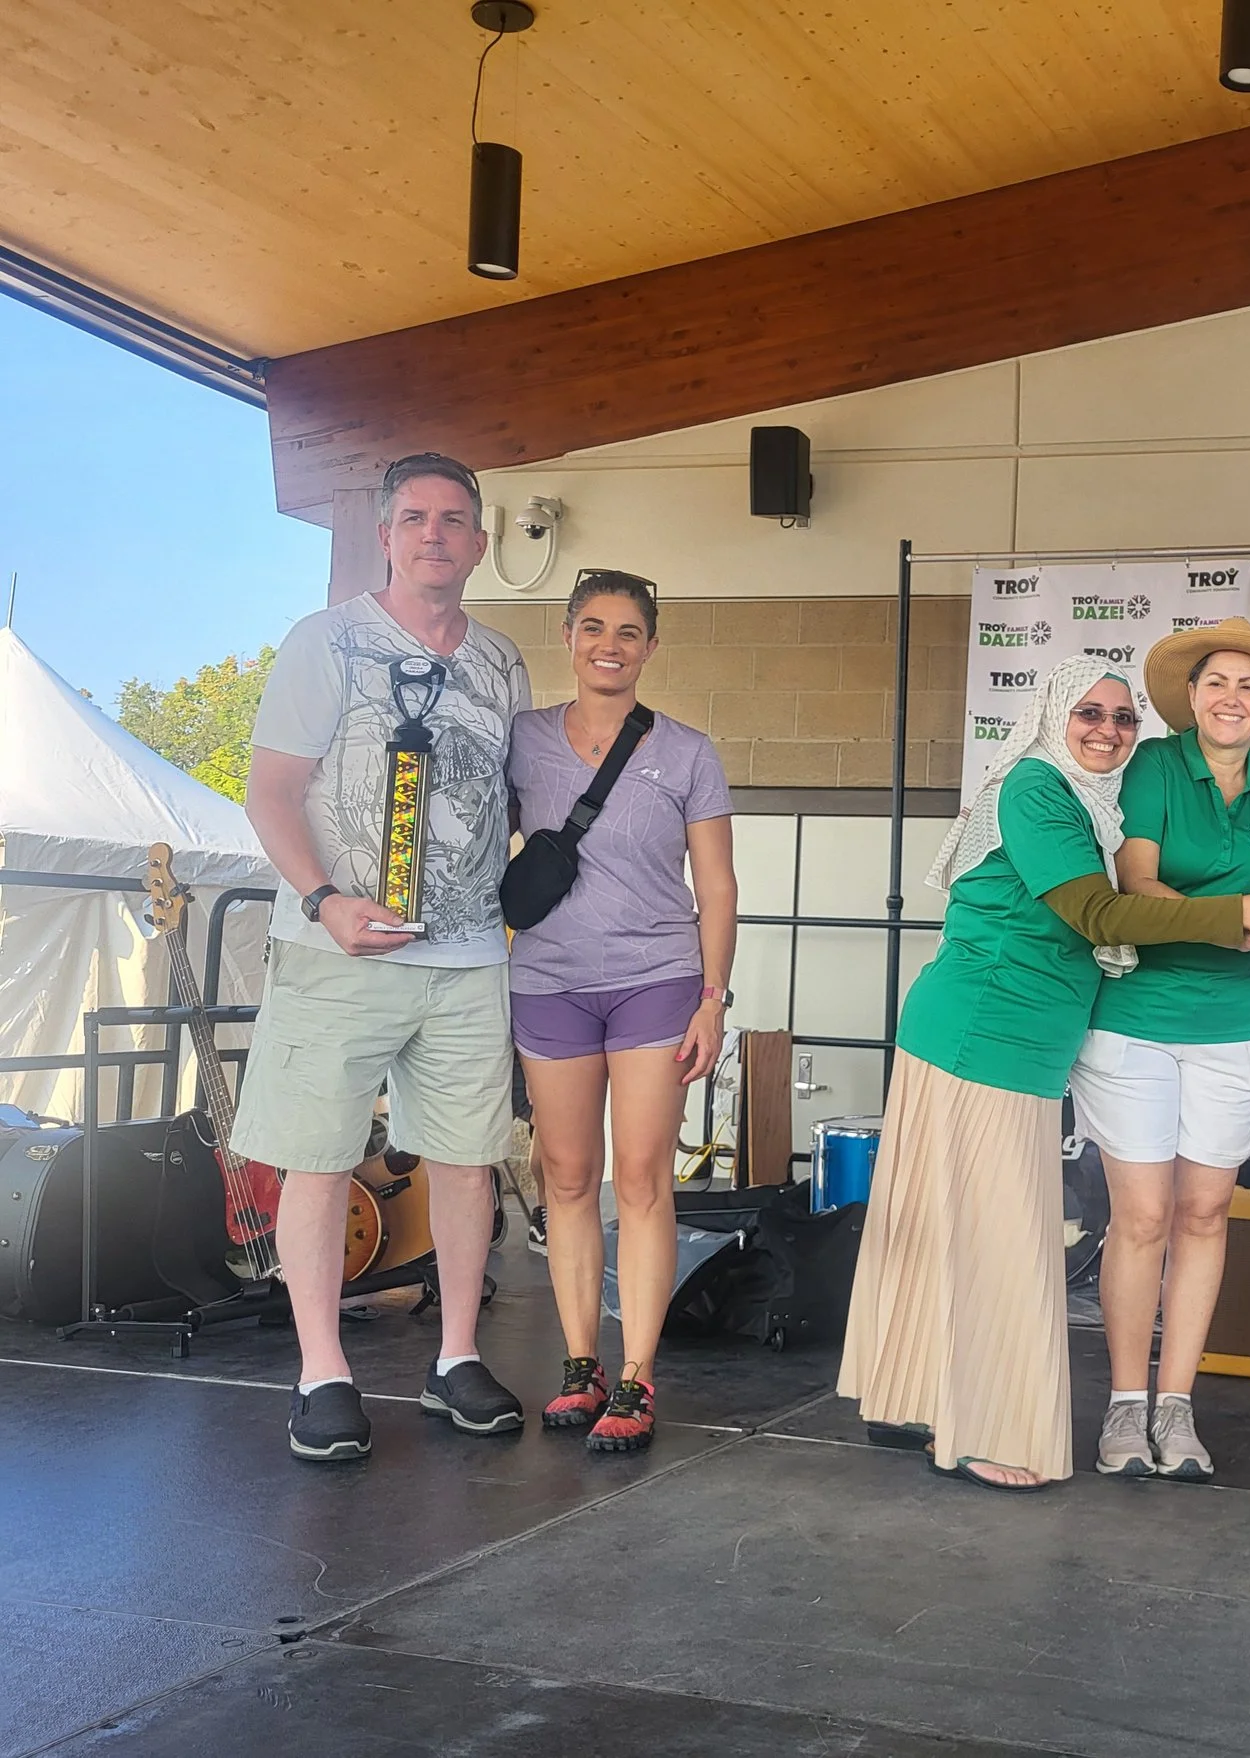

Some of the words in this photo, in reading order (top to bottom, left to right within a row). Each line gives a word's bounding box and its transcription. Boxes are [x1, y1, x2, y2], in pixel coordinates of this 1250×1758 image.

[1188, 568, 1239, 587] TROY
[994, 575, 1039, 594] TROY
[1072, 595, 1099, 605] TROY
[1072, 606, 1124, 620] DAZE!
[979, 622, 1007, 632] TROY
[1172, 616, 1200, 626] TROY
[979, 633, 1028, 647] DAZE!
[990, 668, 1038, 687] TROY
[974, 716, 1003, 725] TROY
[974, 727, 1010, 740] DAZ
